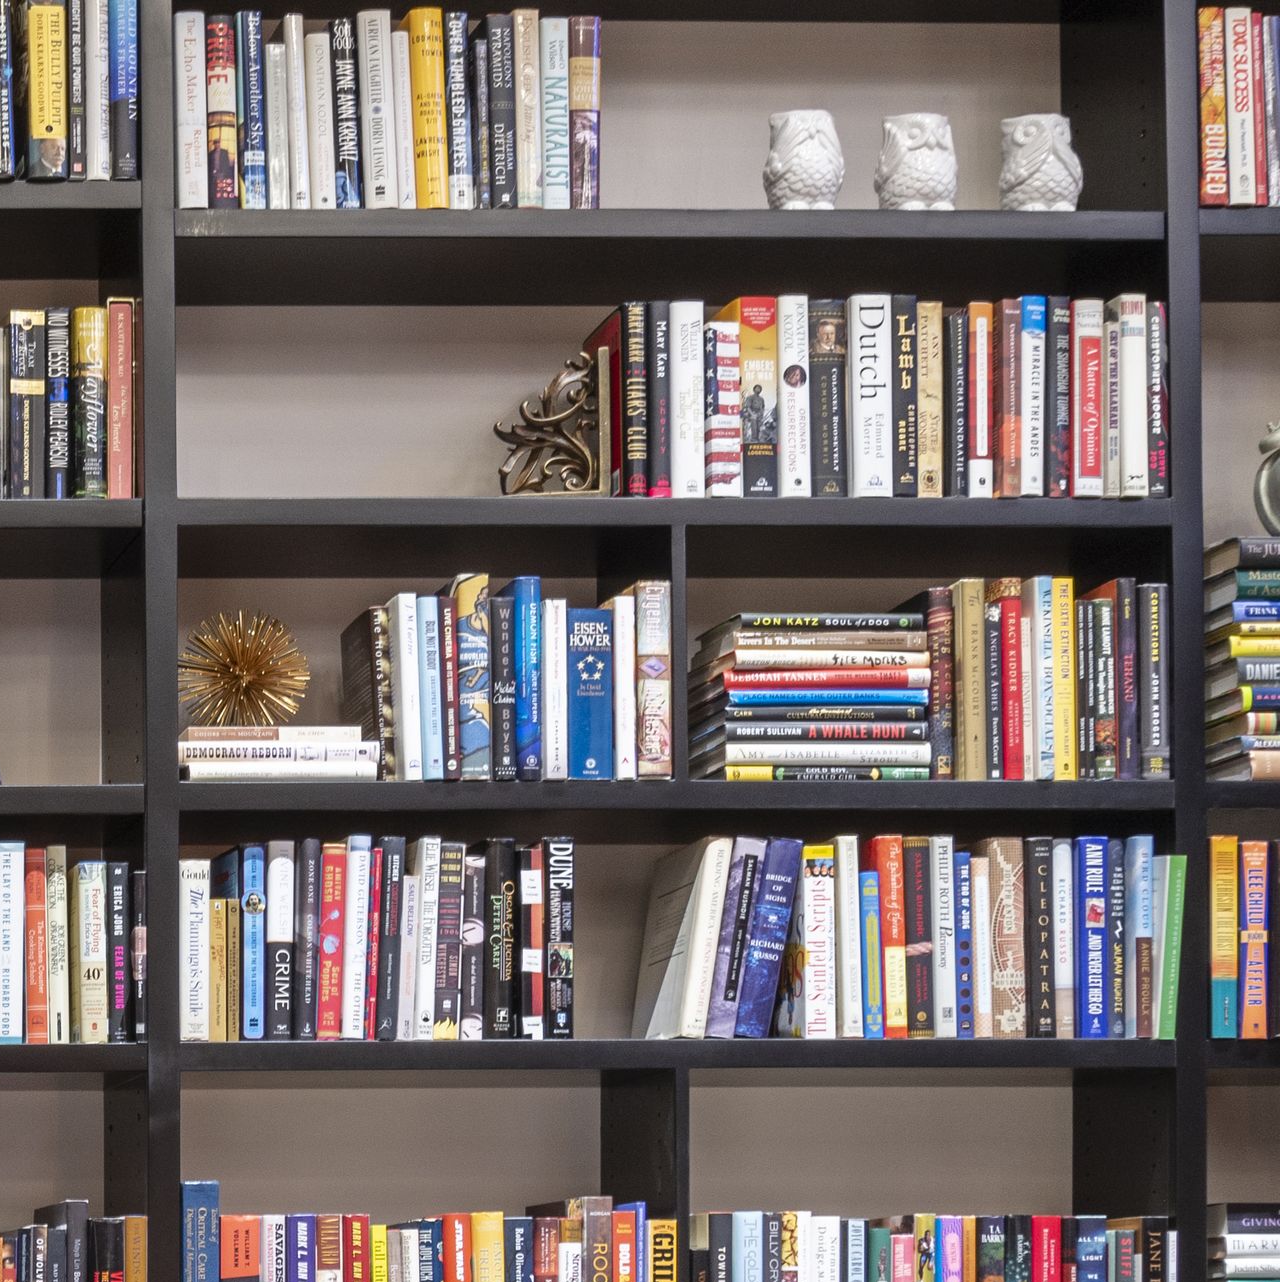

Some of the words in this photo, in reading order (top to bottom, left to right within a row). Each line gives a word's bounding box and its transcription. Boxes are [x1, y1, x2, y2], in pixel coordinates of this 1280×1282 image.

[545, 77, 568, 189] NATURALIST
[1205, 123, 1226, 194] BURNED
[859, 304, 886, 401] Dutch
[574, 622, 608, 634] EISEN-
[754, 617, 780, 626] JON
[787, 617, 819, 626] KATZ
[570, 634, 610, 646] HOWER
[809, 727, 817, 737] A
[827, 726, 867, 738] WHALE
[872, 725, 906, 738] HUNT
[1148, 1232, 1160, 1271] JANE
